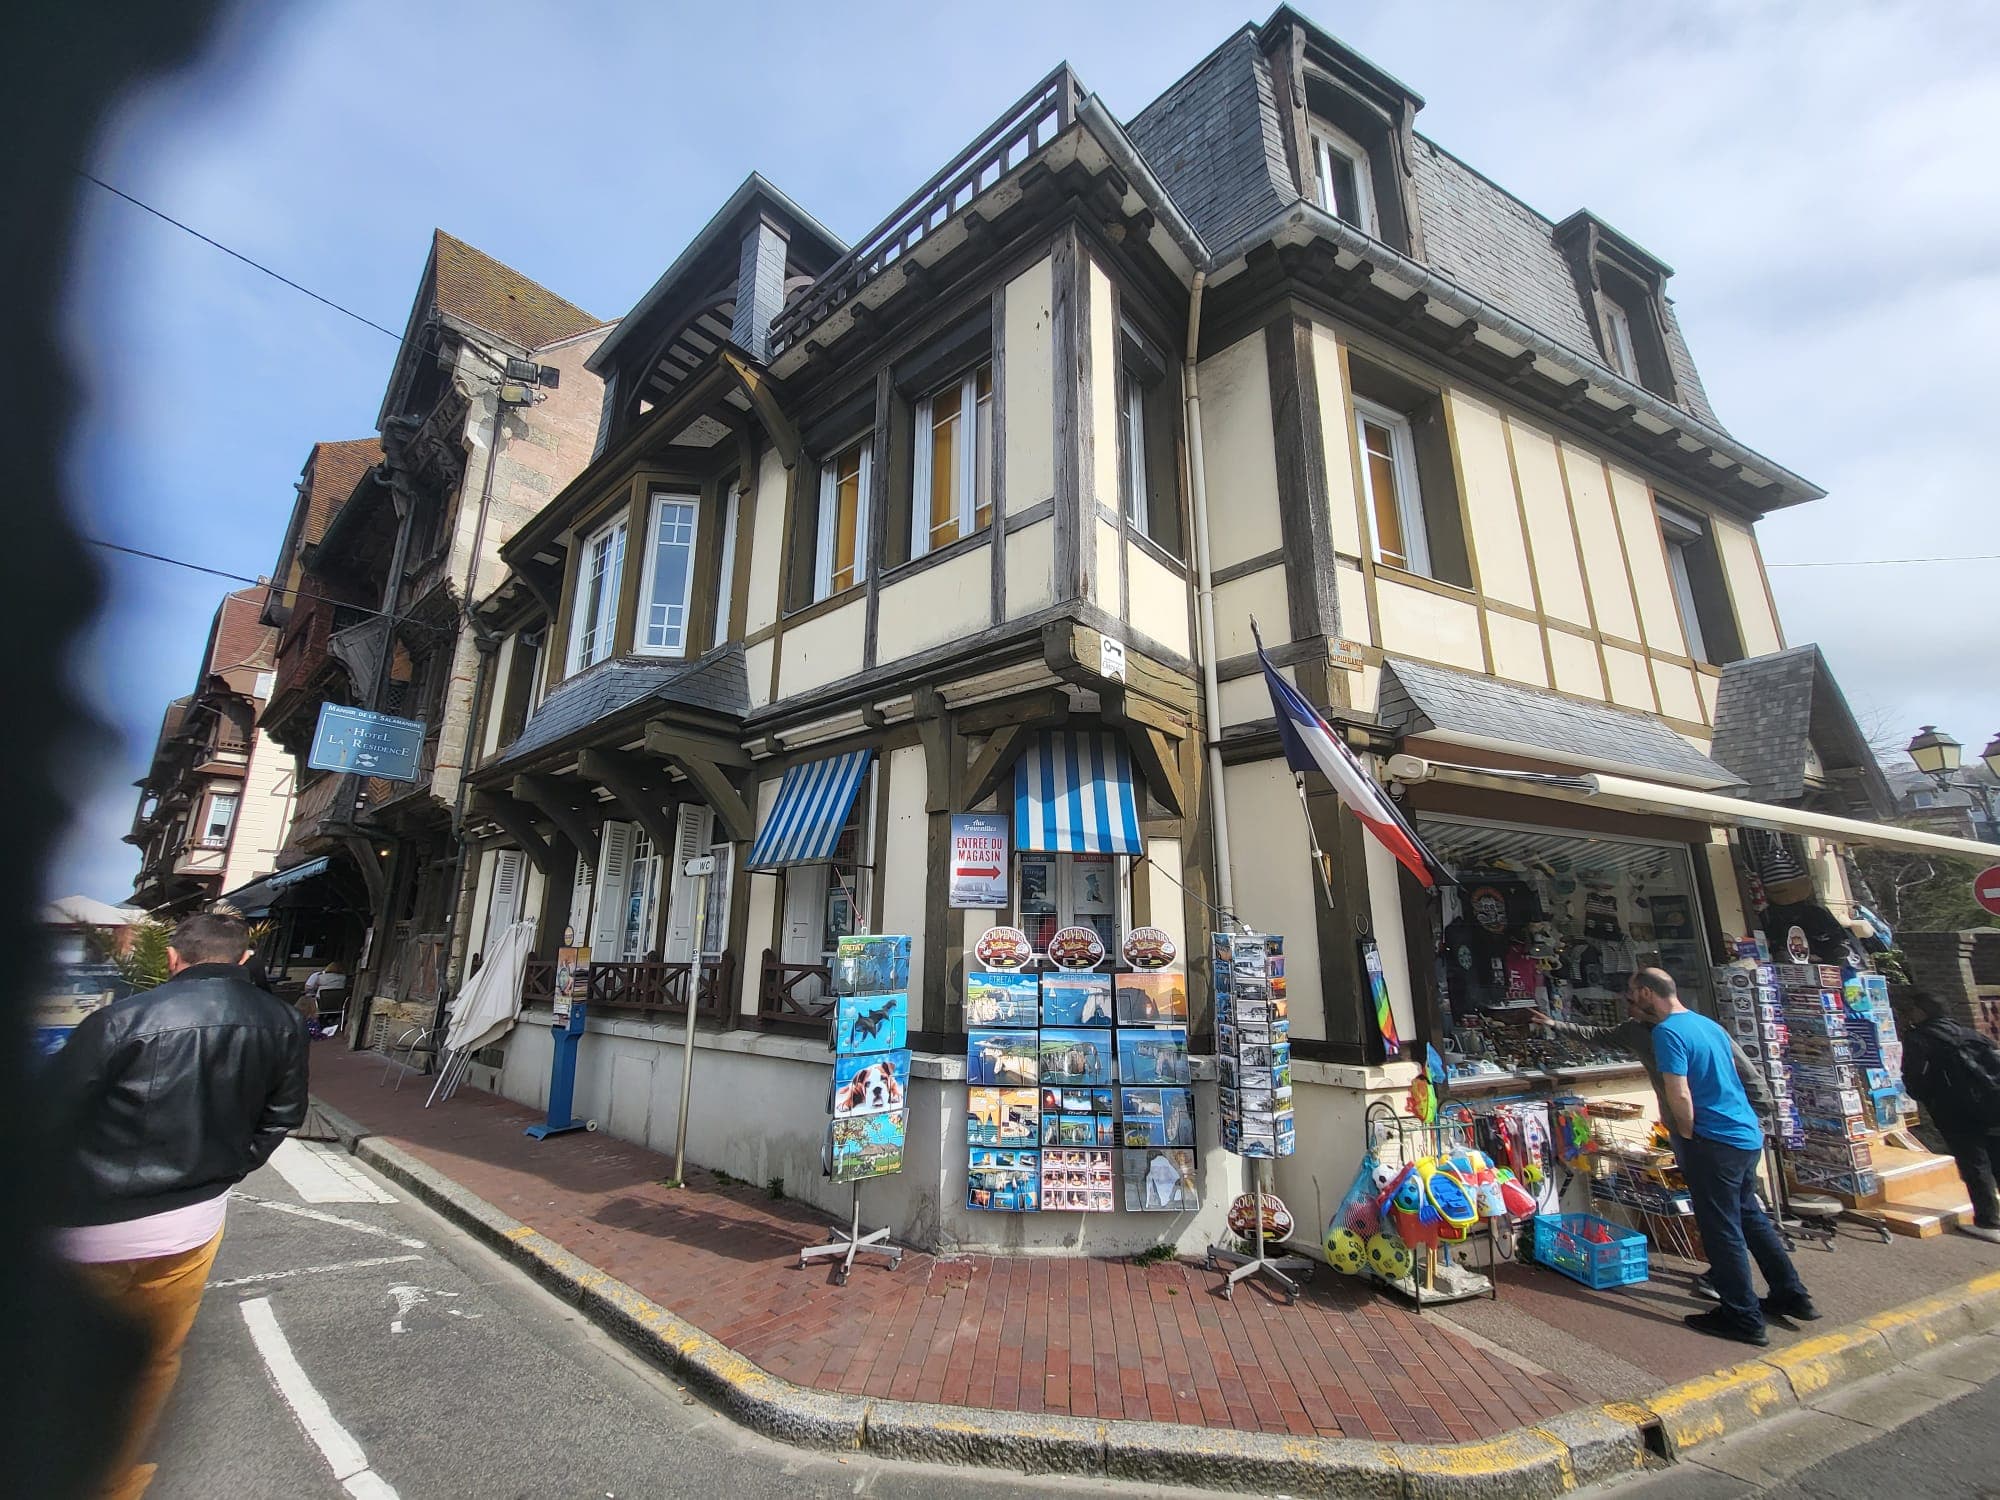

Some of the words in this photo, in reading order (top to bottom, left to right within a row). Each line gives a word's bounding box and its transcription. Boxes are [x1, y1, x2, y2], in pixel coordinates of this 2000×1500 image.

[380, 716, 420, 728] SALAMANDRE
[957, 836, 988, 850] ENTRÉE
[992, 838, 1002, 850] DU
[958, 850, 1001, 862] MAGASIN
[699, 860, 710, 871] WC
[984, 928, 1024, 943] SOUVENIRS
[1056, 929, 1096, 942] SOUVENIRS
[1130, 929, 1169, 942] SOUVENIRS
[1234, 1194, 1282, 1212] SOUVNIRS
